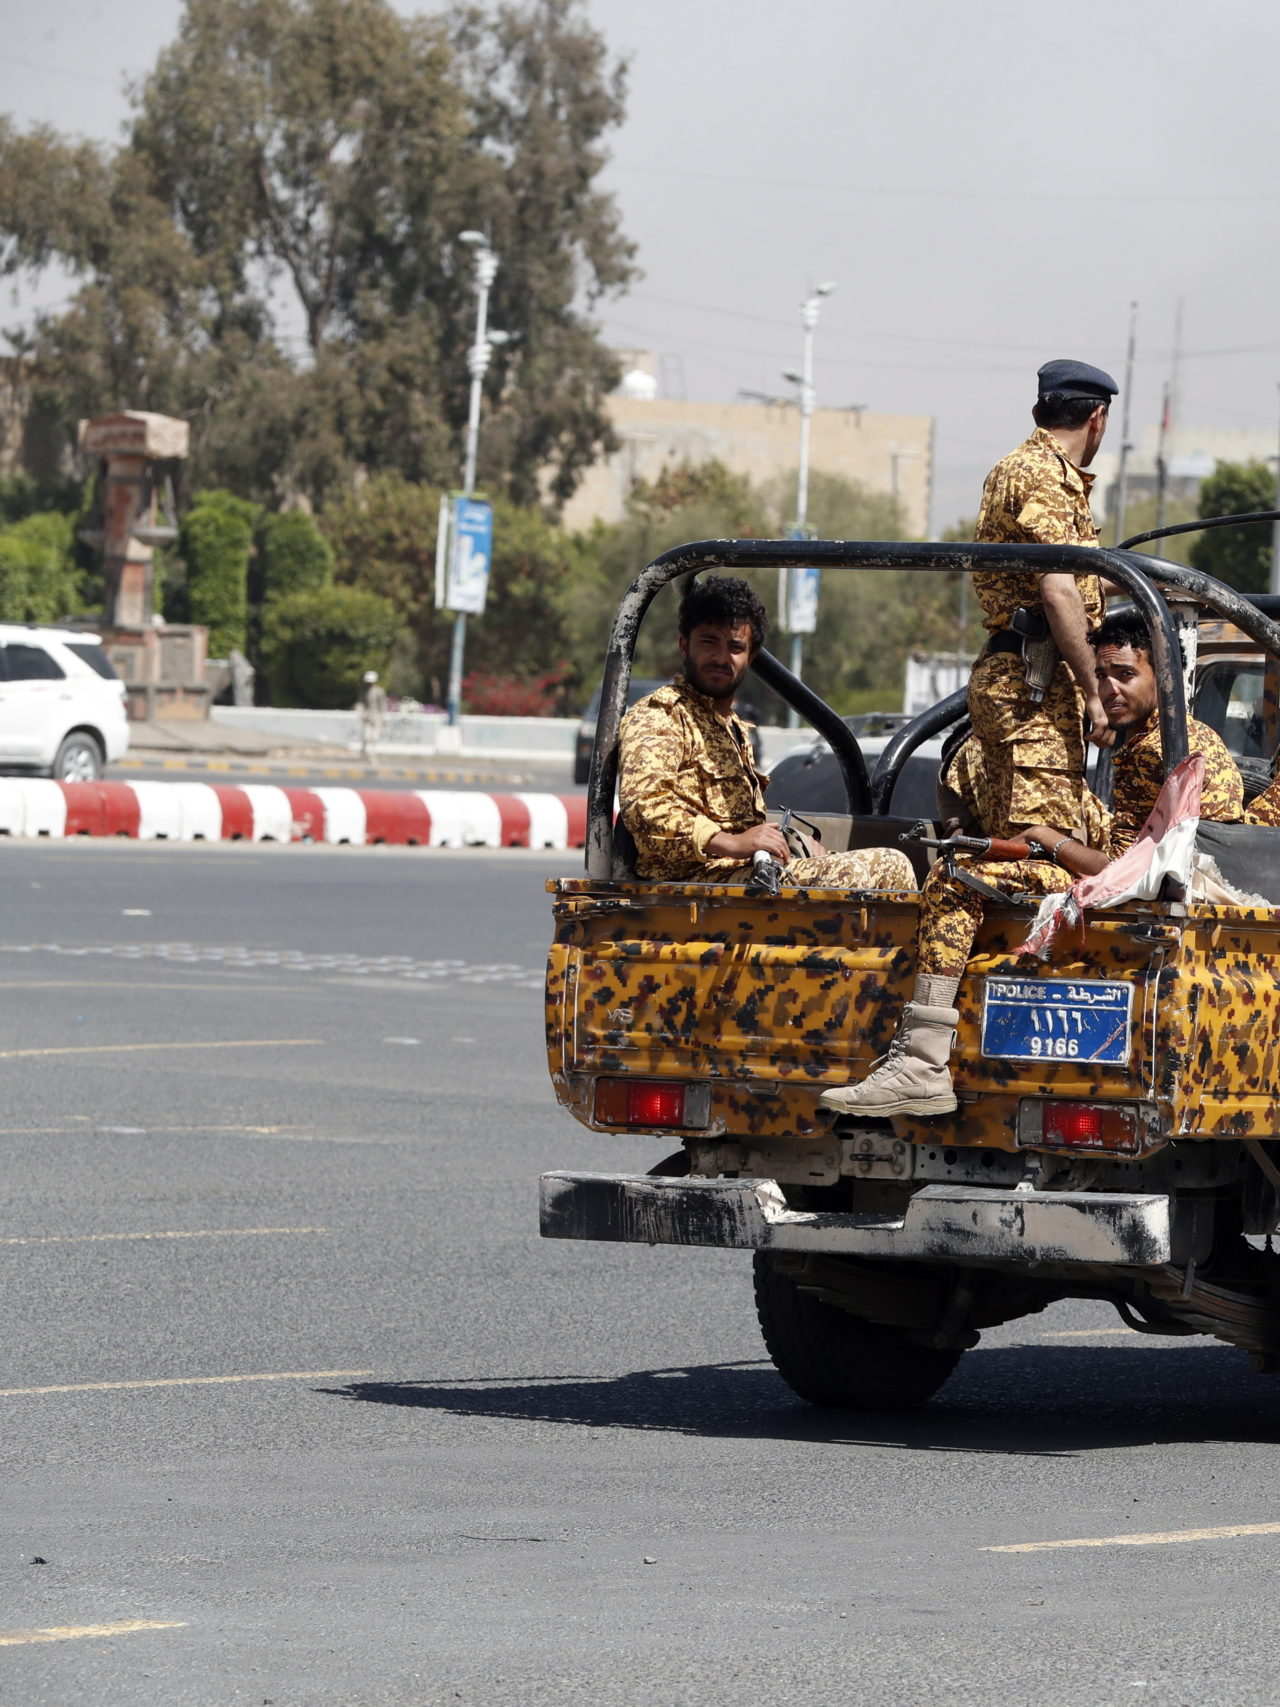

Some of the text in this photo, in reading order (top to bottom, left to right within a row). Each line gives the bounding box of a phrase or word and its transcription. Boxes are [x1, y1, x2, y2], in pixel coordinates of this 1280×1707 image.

[996, 983, 1047, 1000] POLICE
[1067, 986, 1121, 1004] الشرطة
[1031, 1036, 1079, 1057] 9166
